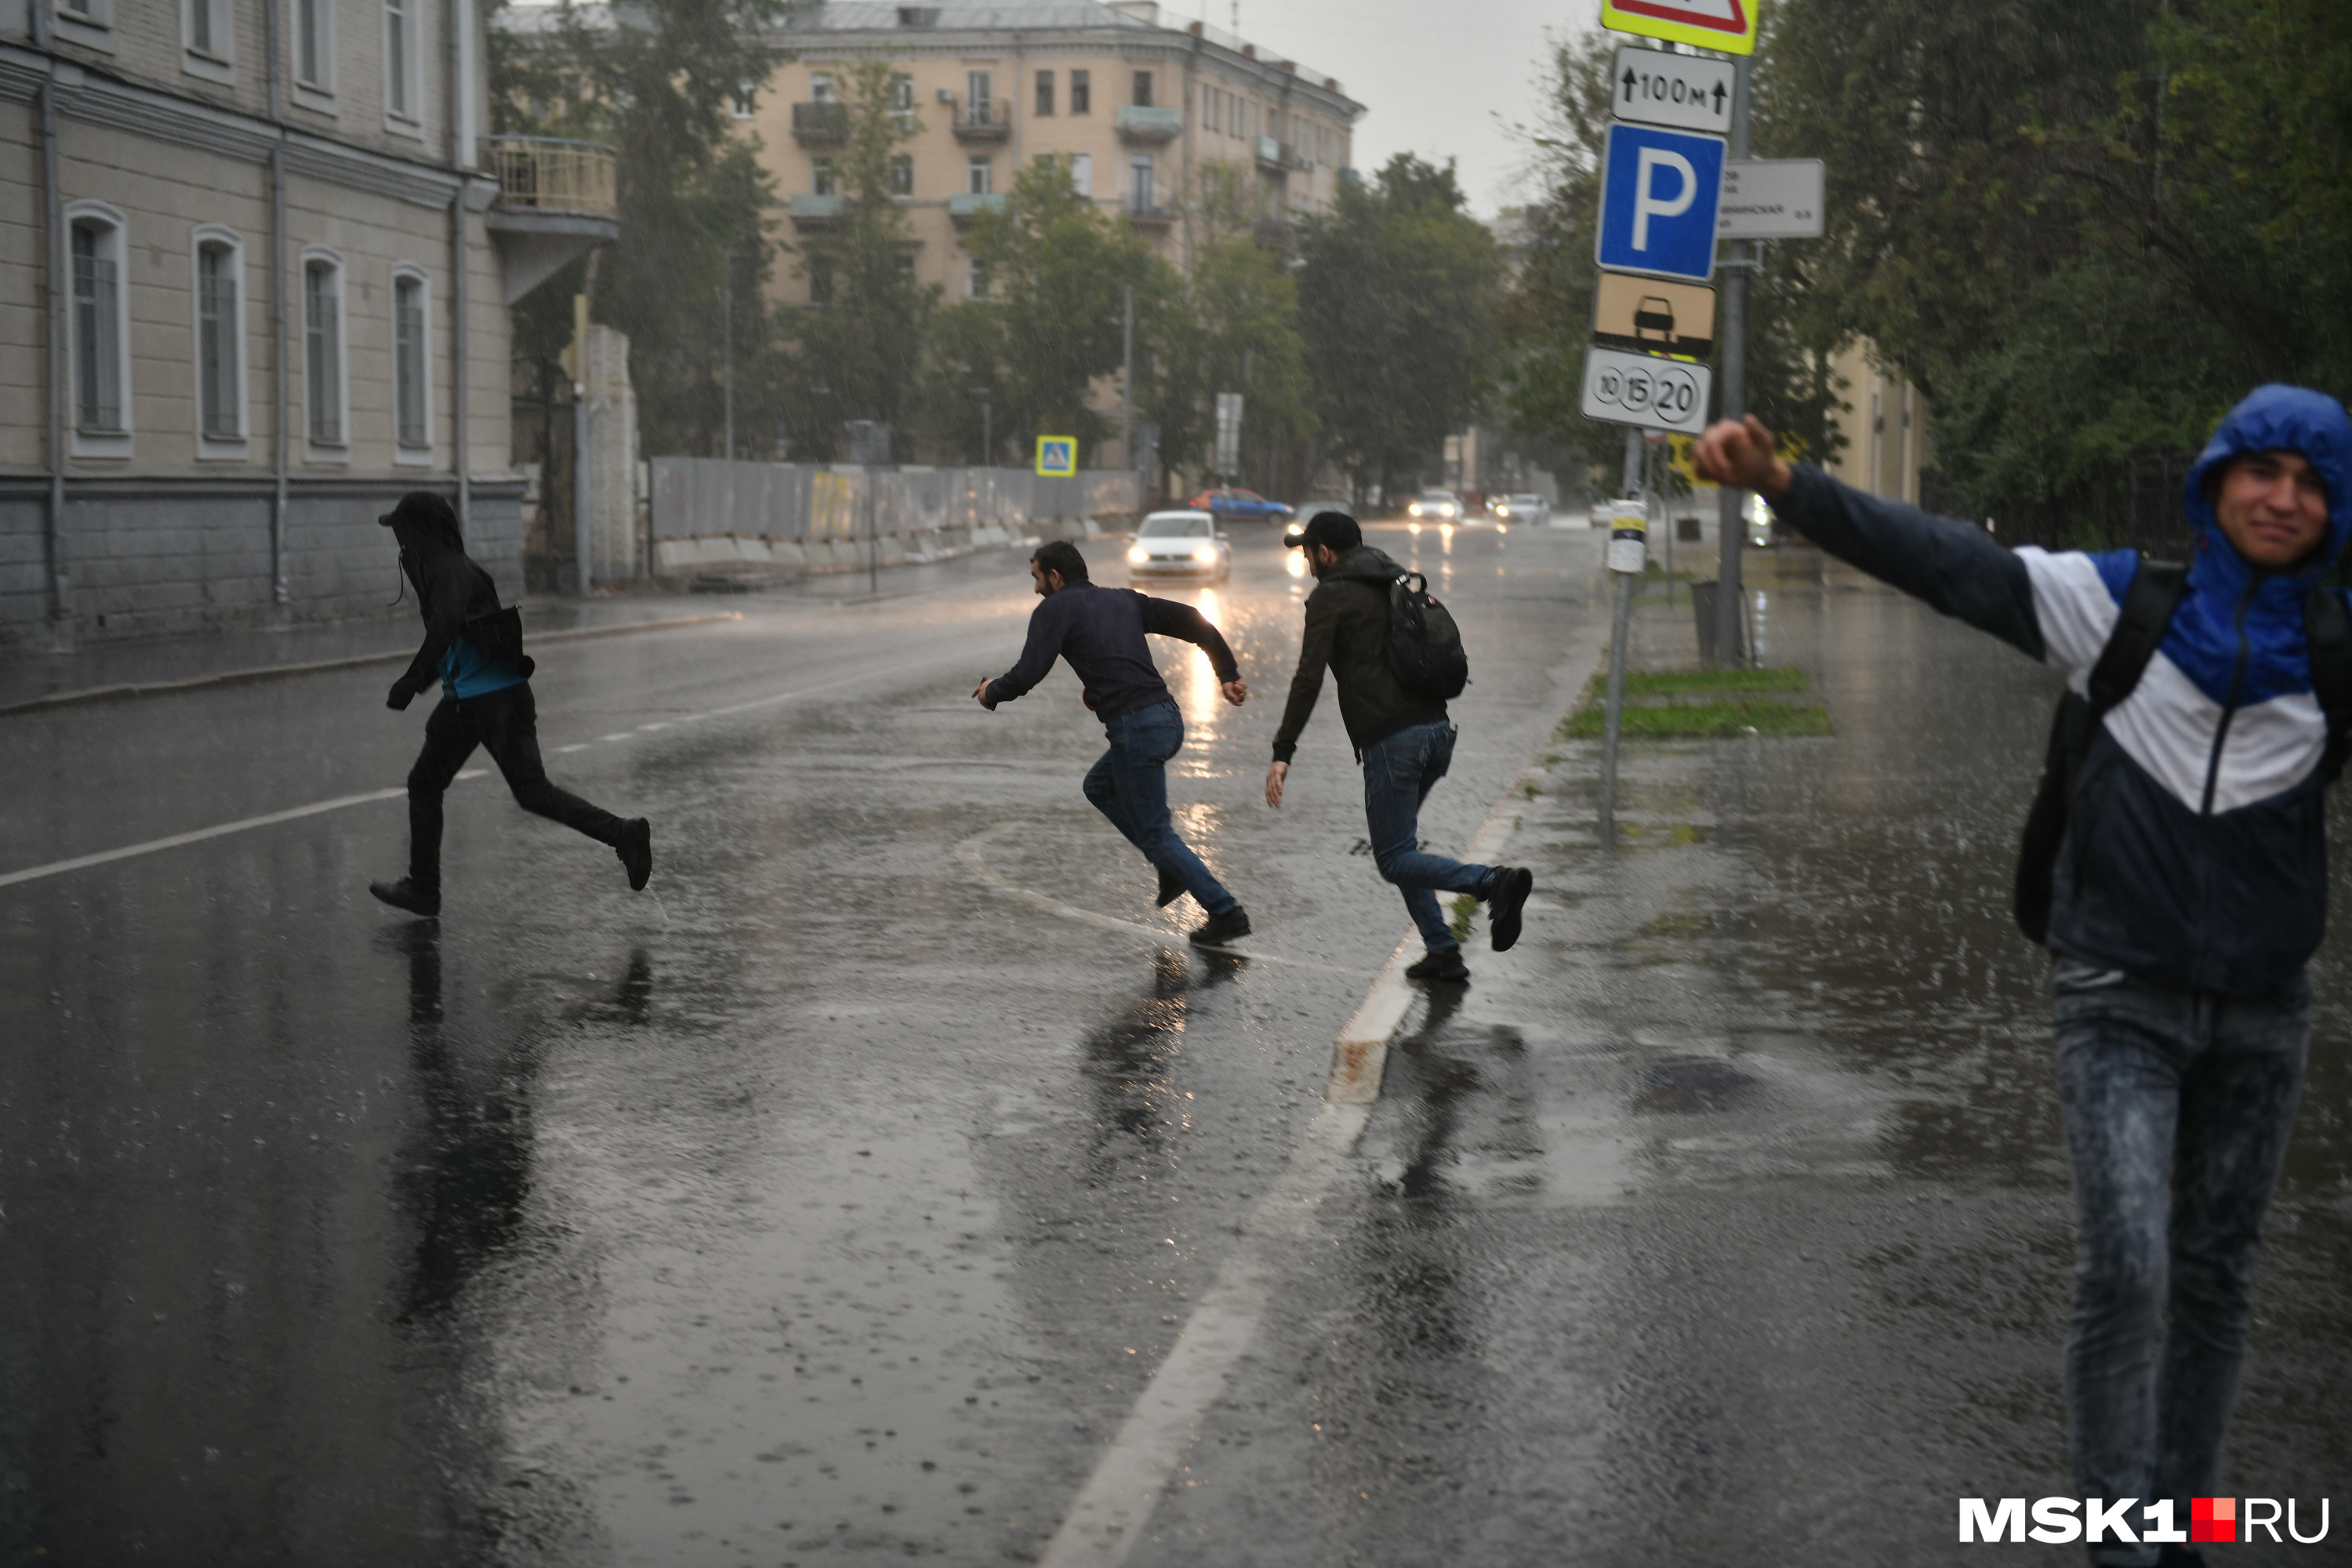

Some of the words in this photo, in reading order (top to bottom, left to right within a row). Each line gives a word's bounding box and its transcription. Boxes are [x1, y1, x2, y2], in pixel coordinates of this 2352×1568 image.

[1631, 146, 1697, 252] P
[1600, 374, 1620, 395] 10
[1627, 376, 1649, 402] 15
[1657, 380, 1693, 412] 20
